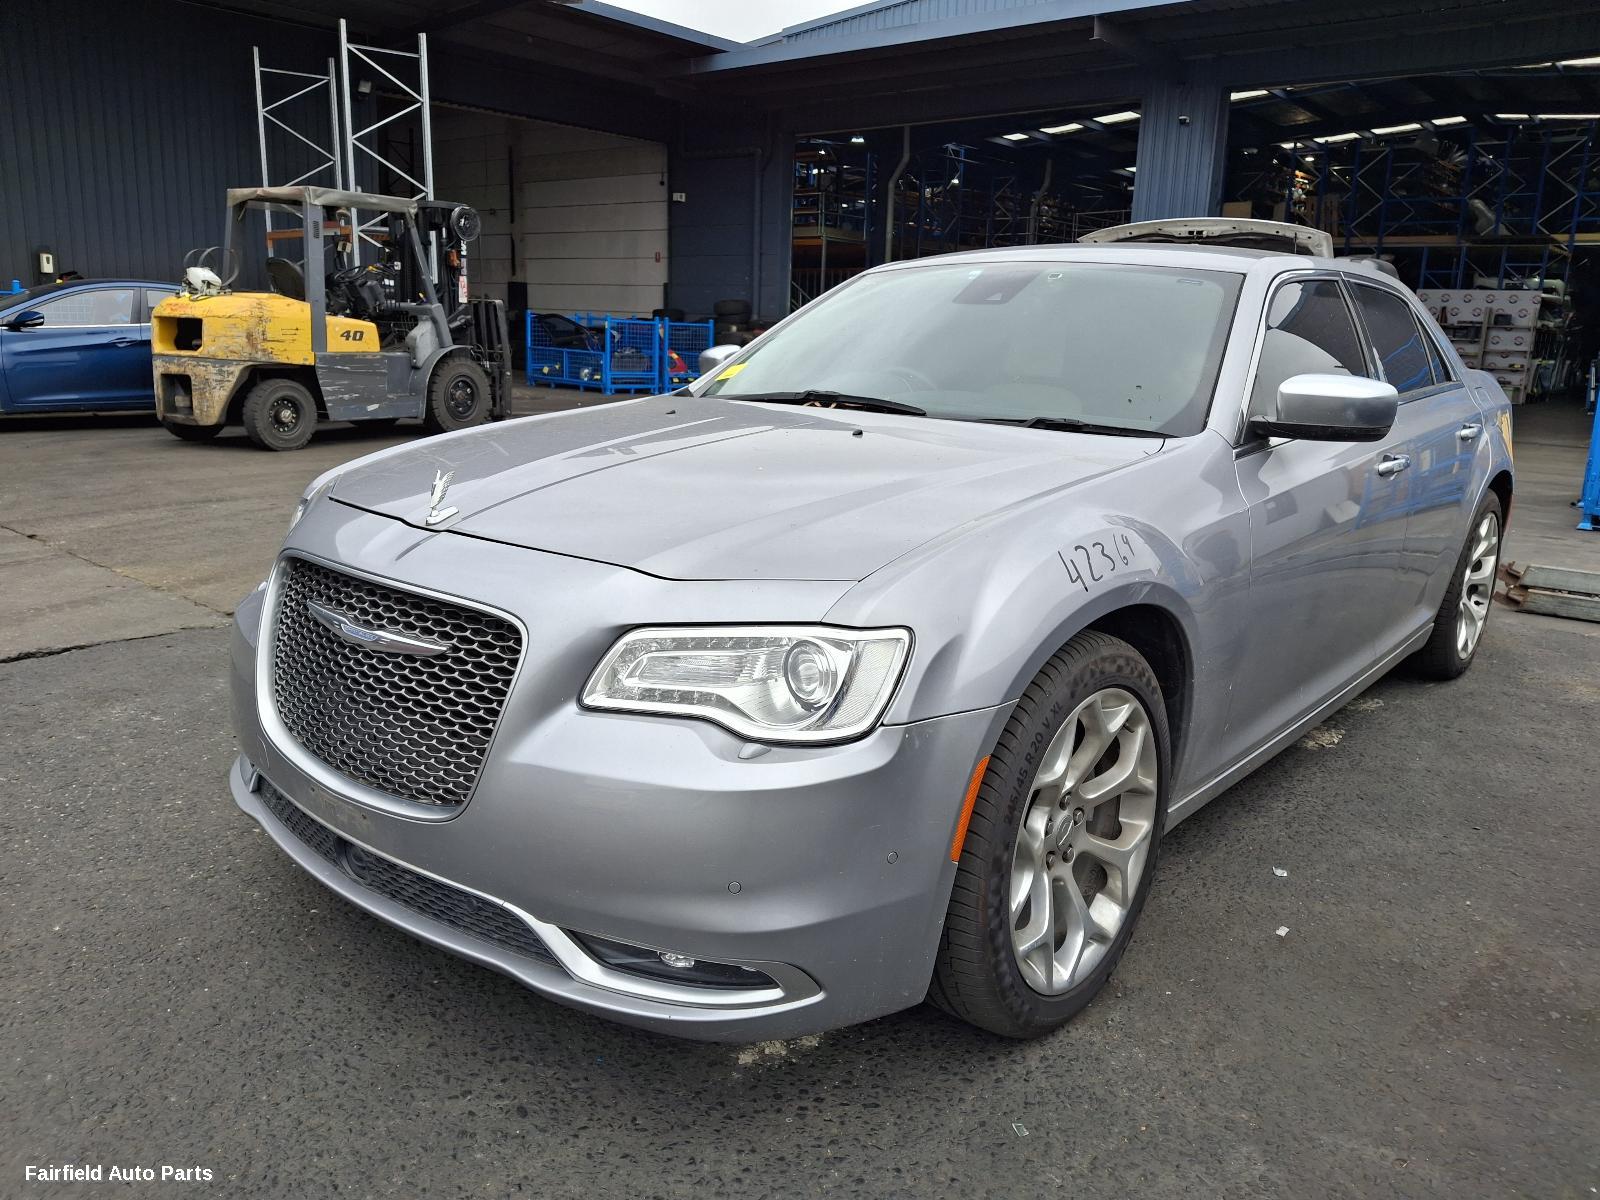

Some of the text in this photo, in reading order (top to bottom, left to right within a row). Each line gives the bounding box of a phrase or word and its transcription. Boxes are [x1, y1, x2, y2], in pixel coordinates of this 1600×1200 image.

[340, 330, 364, 341] 40
[1025, 752, 1035, 765] R
[1031, 732, 1044, 753] 20
